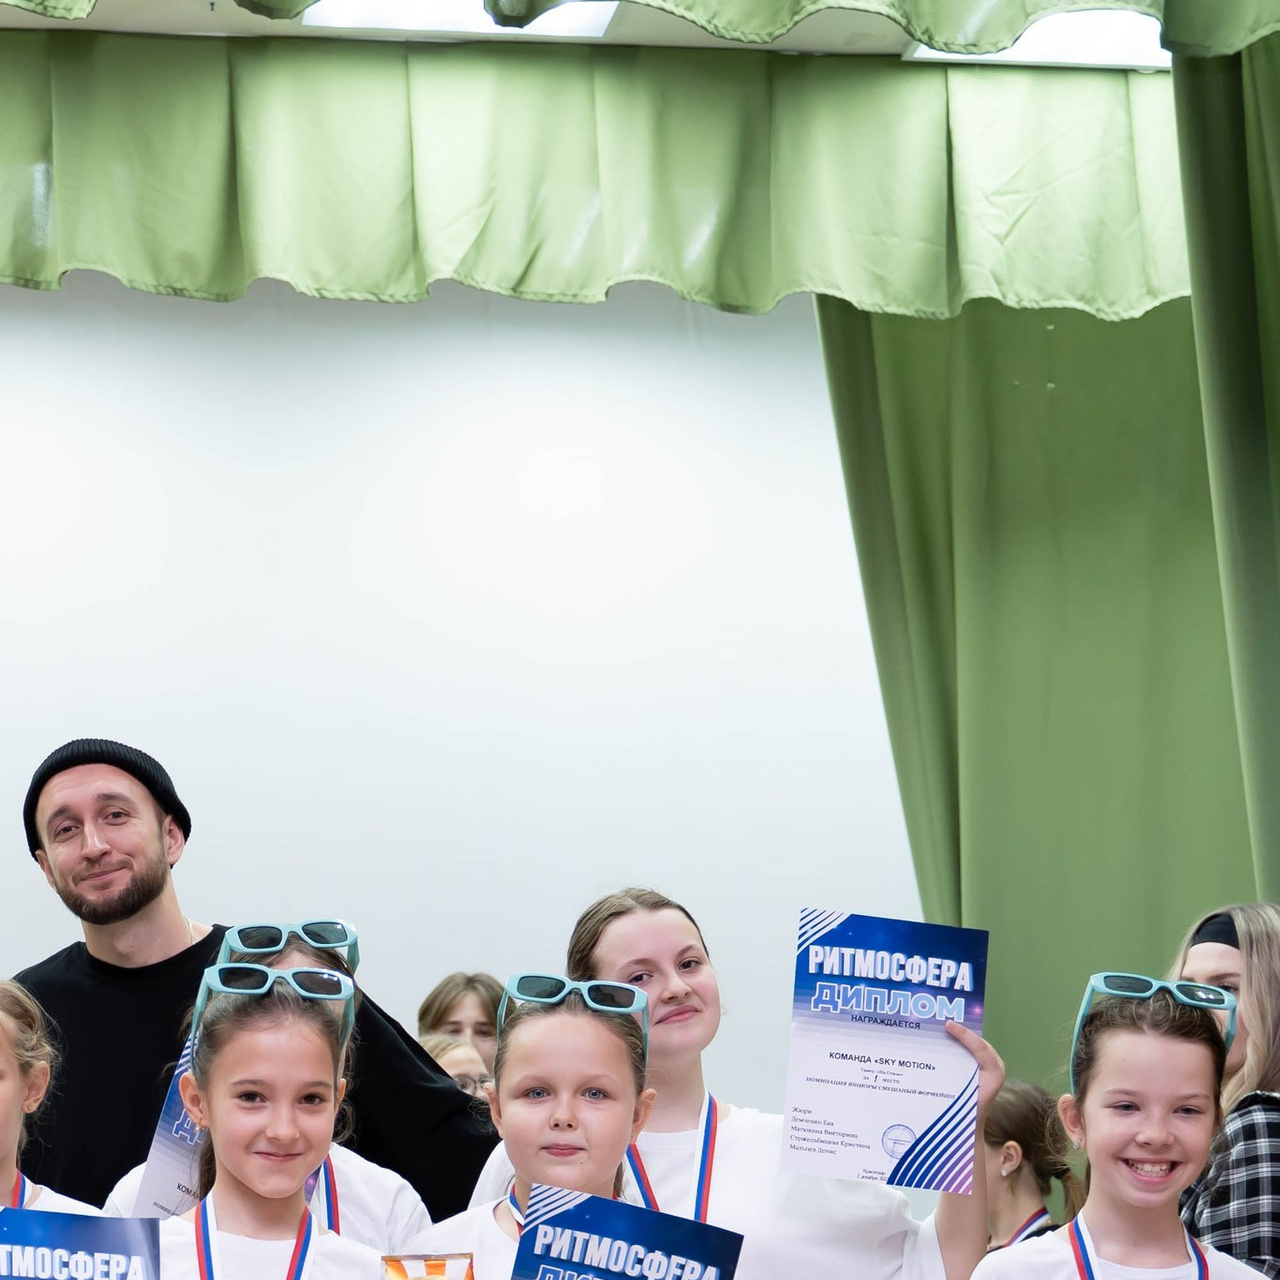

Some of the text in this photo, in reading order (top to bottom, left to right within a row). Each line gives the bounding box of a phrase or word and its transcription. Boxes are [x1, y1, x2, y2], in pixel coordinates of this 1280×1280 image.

[808, 944, 973, 992] РИТМОСФЕРА
[811, 981, 965, 1023] ДИПЛОМ
[851, 1014, 921, 1030] НАГРАЖДАЕТСЯ
[829, 1052, 936, 1071] КОМАНДА «SKY MOTION»
[806, 1076, 847, 1086] НОМИНАЦИЯ
